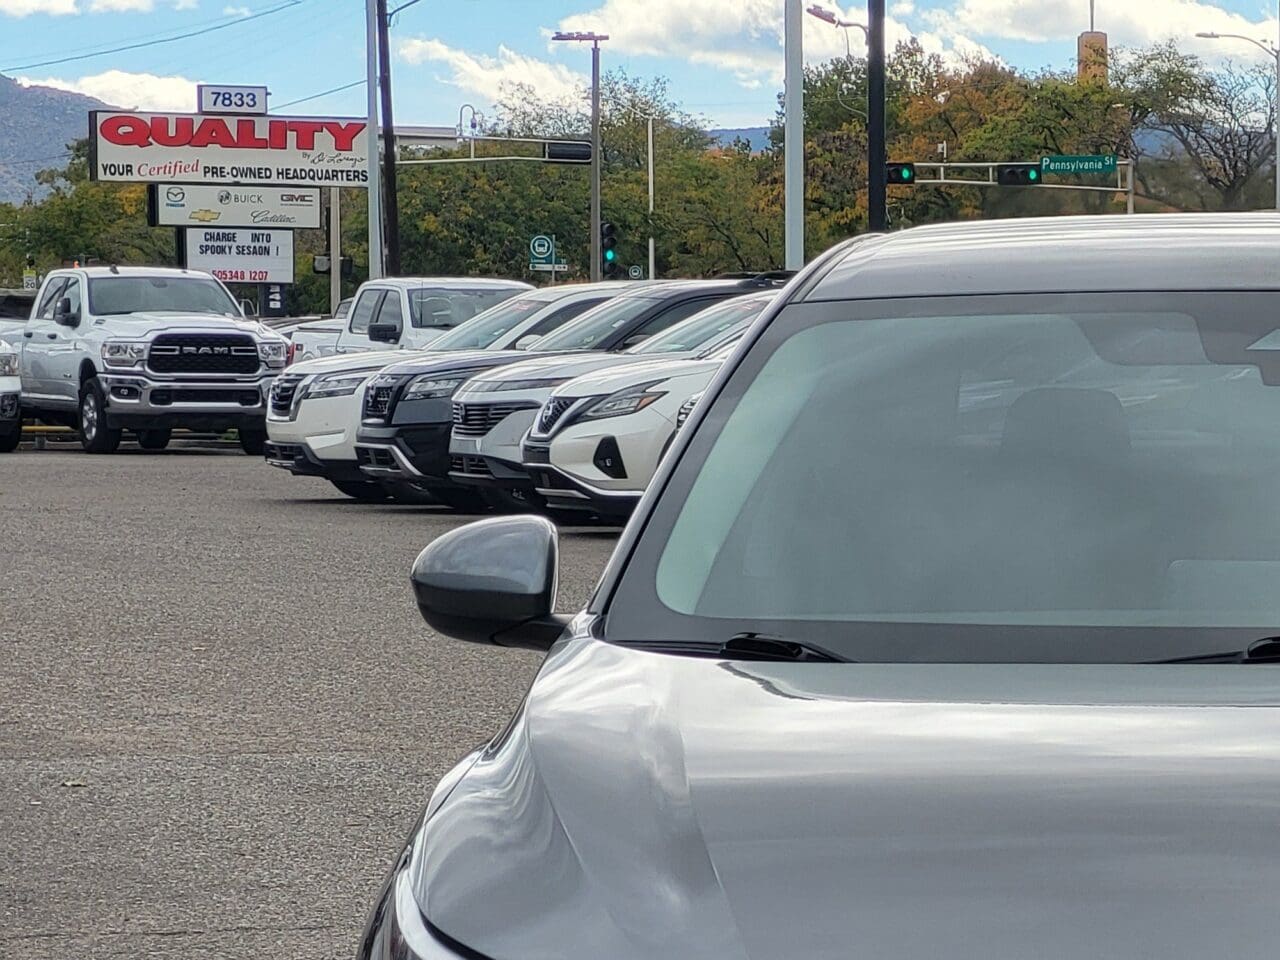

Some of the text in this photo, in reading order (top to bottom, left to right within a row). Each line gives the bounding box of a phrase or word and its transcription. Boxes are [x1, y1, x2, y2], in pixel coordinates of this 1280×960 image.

[211, 91, 257, 108] 7833
[100, 115, 367, 152] QUALITY
[1042, 156, 1113, 172] Pennsylvania St
[101, 159, 368, 182] YOUR Certified PRE-OWNED HEADQUARTERS
[234, 194, 263, 204] BUICK
[280, 194, 313, 202] GMC
[204, 231, 271, 243] CHARGE INTO
[199, 245, 232, 255] SPOOKY
[249, 271, 268, 281] 1207
[183, 346, 228, 354] RAM
